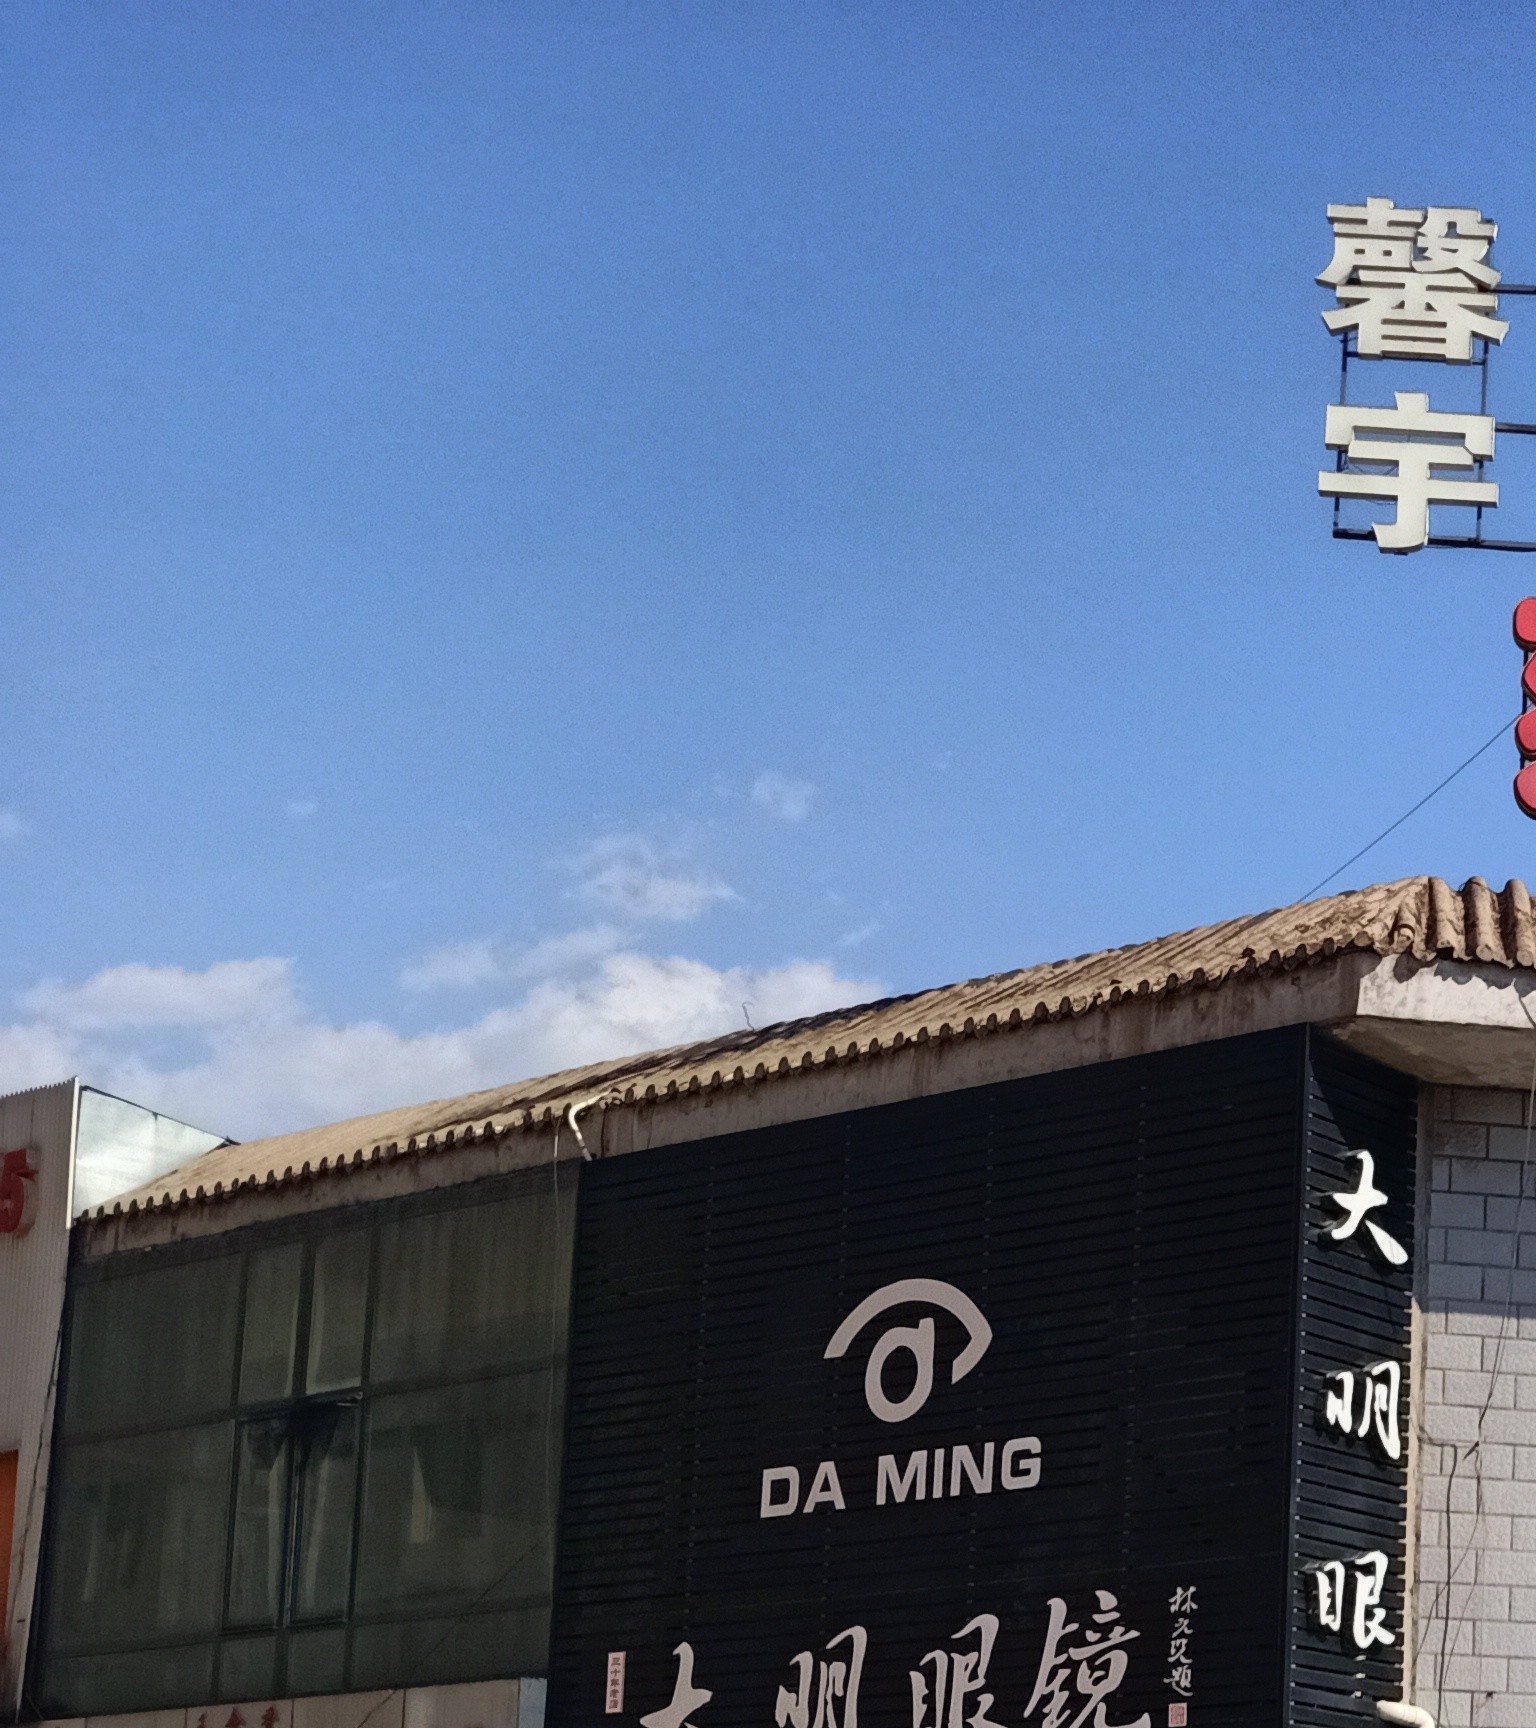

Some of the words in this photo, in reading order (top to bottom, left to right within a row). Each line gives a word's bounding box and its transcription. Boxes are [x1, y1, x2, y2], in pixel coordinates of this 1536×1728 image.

[1320, 197, 1510, 554] 馨宇
[760, 1459, 846, 1519] DA
[874, 1435, 1042, 1507] MING
